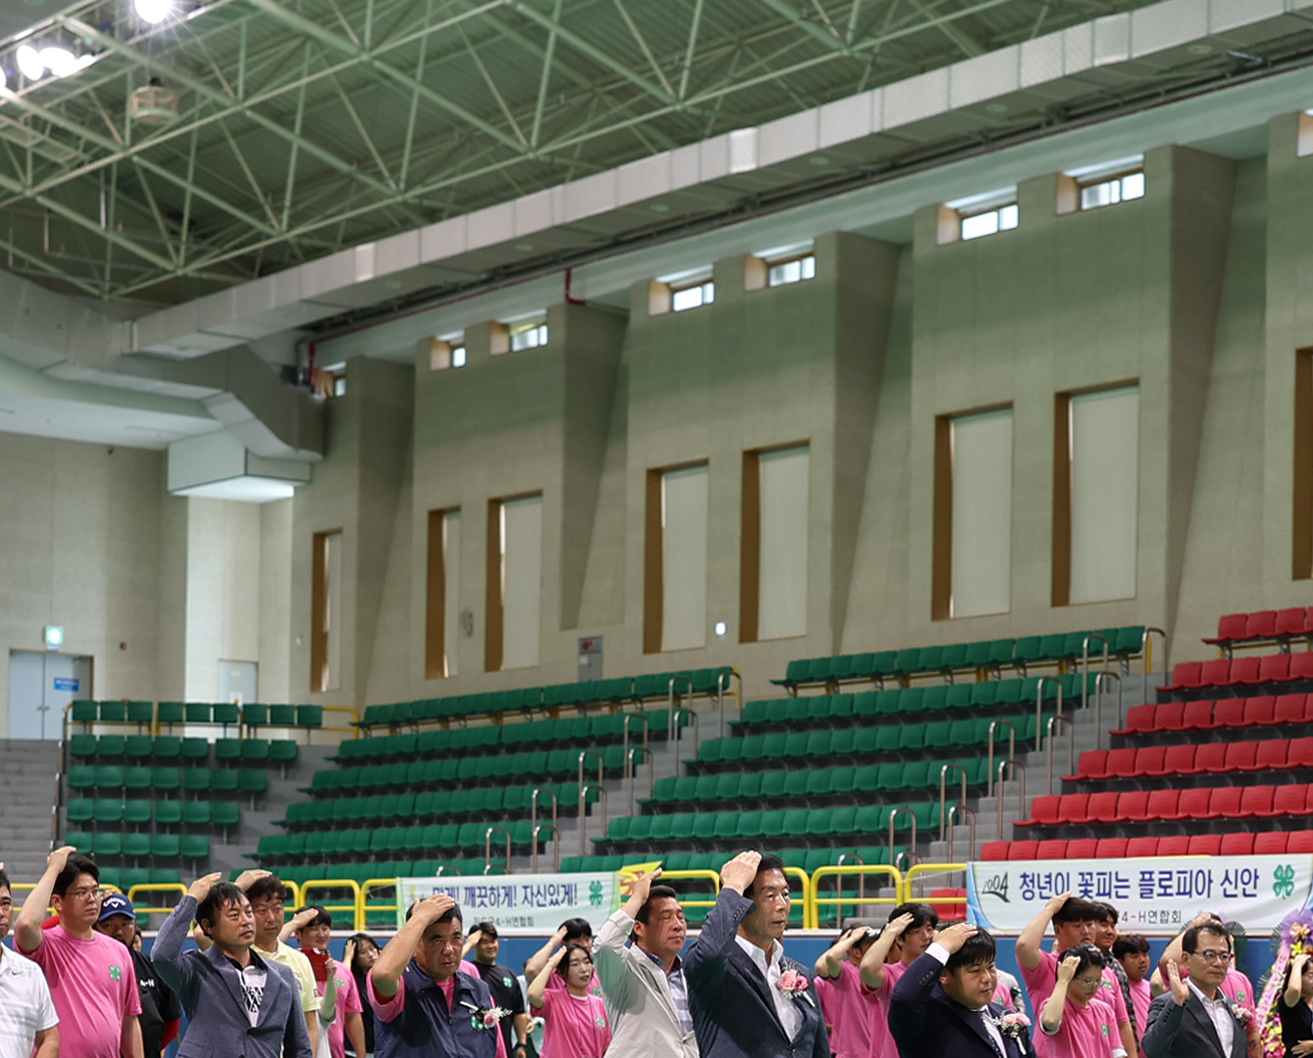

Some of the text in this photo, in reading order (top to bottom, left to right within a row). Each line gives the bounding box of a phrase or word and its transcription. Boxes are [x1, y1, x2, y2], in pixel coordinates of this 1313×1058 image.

[463, 884, 517, 908] 깨끗하게!
[522, 882, 578, 908] 자신있게!
[1019, 868, 1260, 901] 청년이 꽃피는 플로피아 신안
[1117, 910, 1182, 924] 4-H연합회
